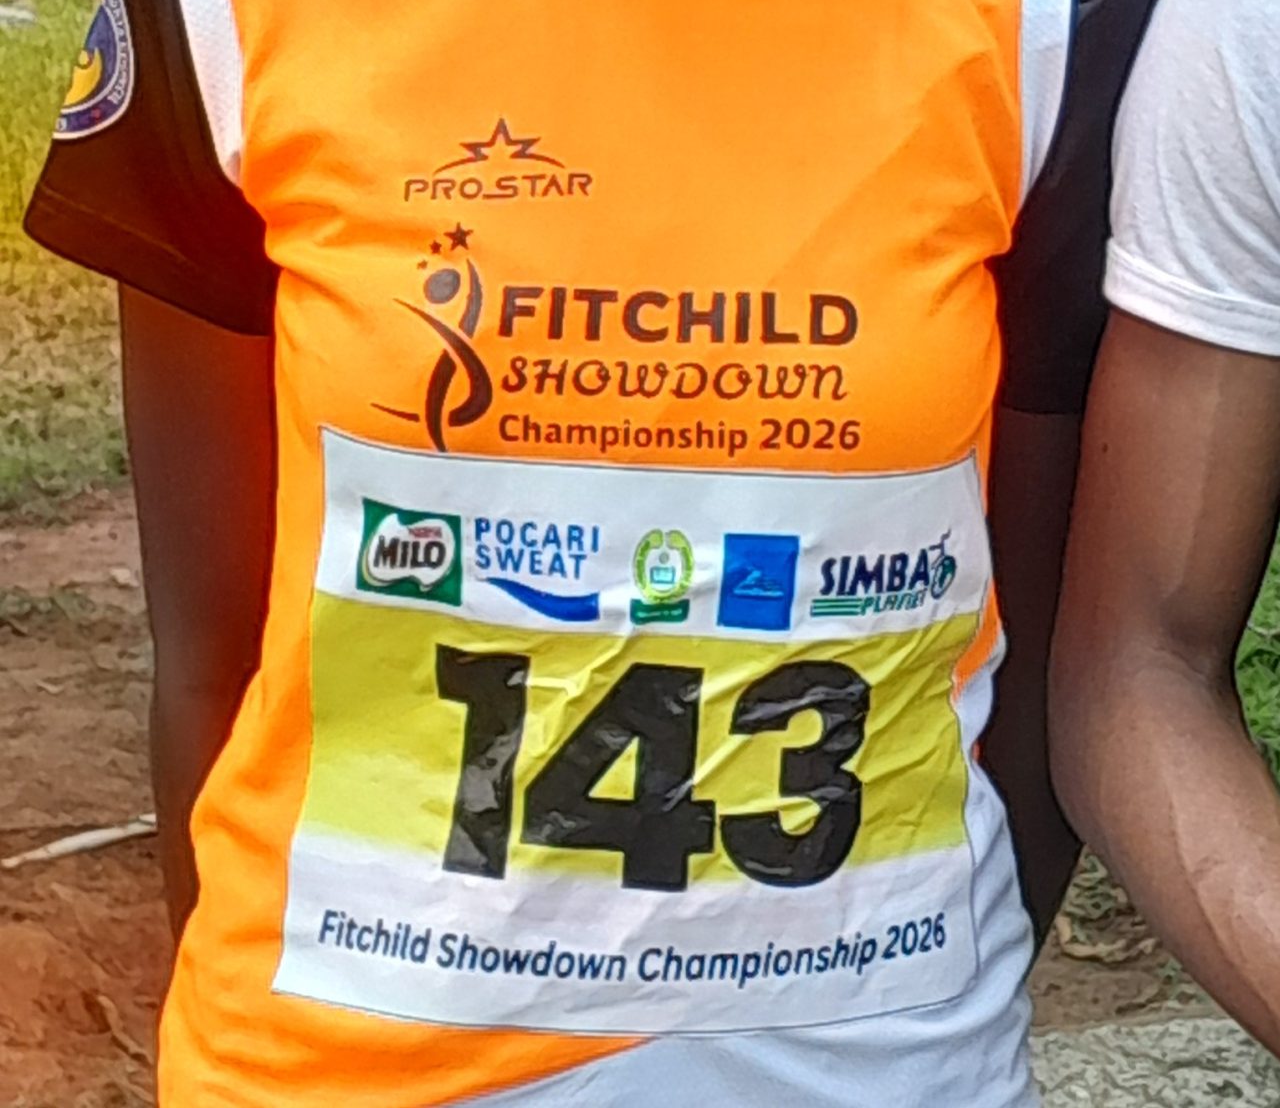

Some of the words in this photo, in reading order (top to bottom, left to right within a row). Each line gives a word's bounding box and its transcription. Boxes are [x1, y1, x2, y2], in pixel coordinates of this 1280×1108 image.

[498, 286, 859, 345] FITCHILD
[499, 414, 748, 457] Championship
[758, 418, 861, 451] 2026
[373, 535, 447, 570] MILO
[474, 517, 600, 554] POCARI
[474, 544, 588, 580] SWEAT
[819, 548, 930, 596] SIMBA
[435, 643, 872, 892] 143
[318, 909, 432, 964] Fitchild
[436, 933, 627, 982] Showdown
[637, 931, 878, 990] Championship
[881, 912, 946, 960] 2026
